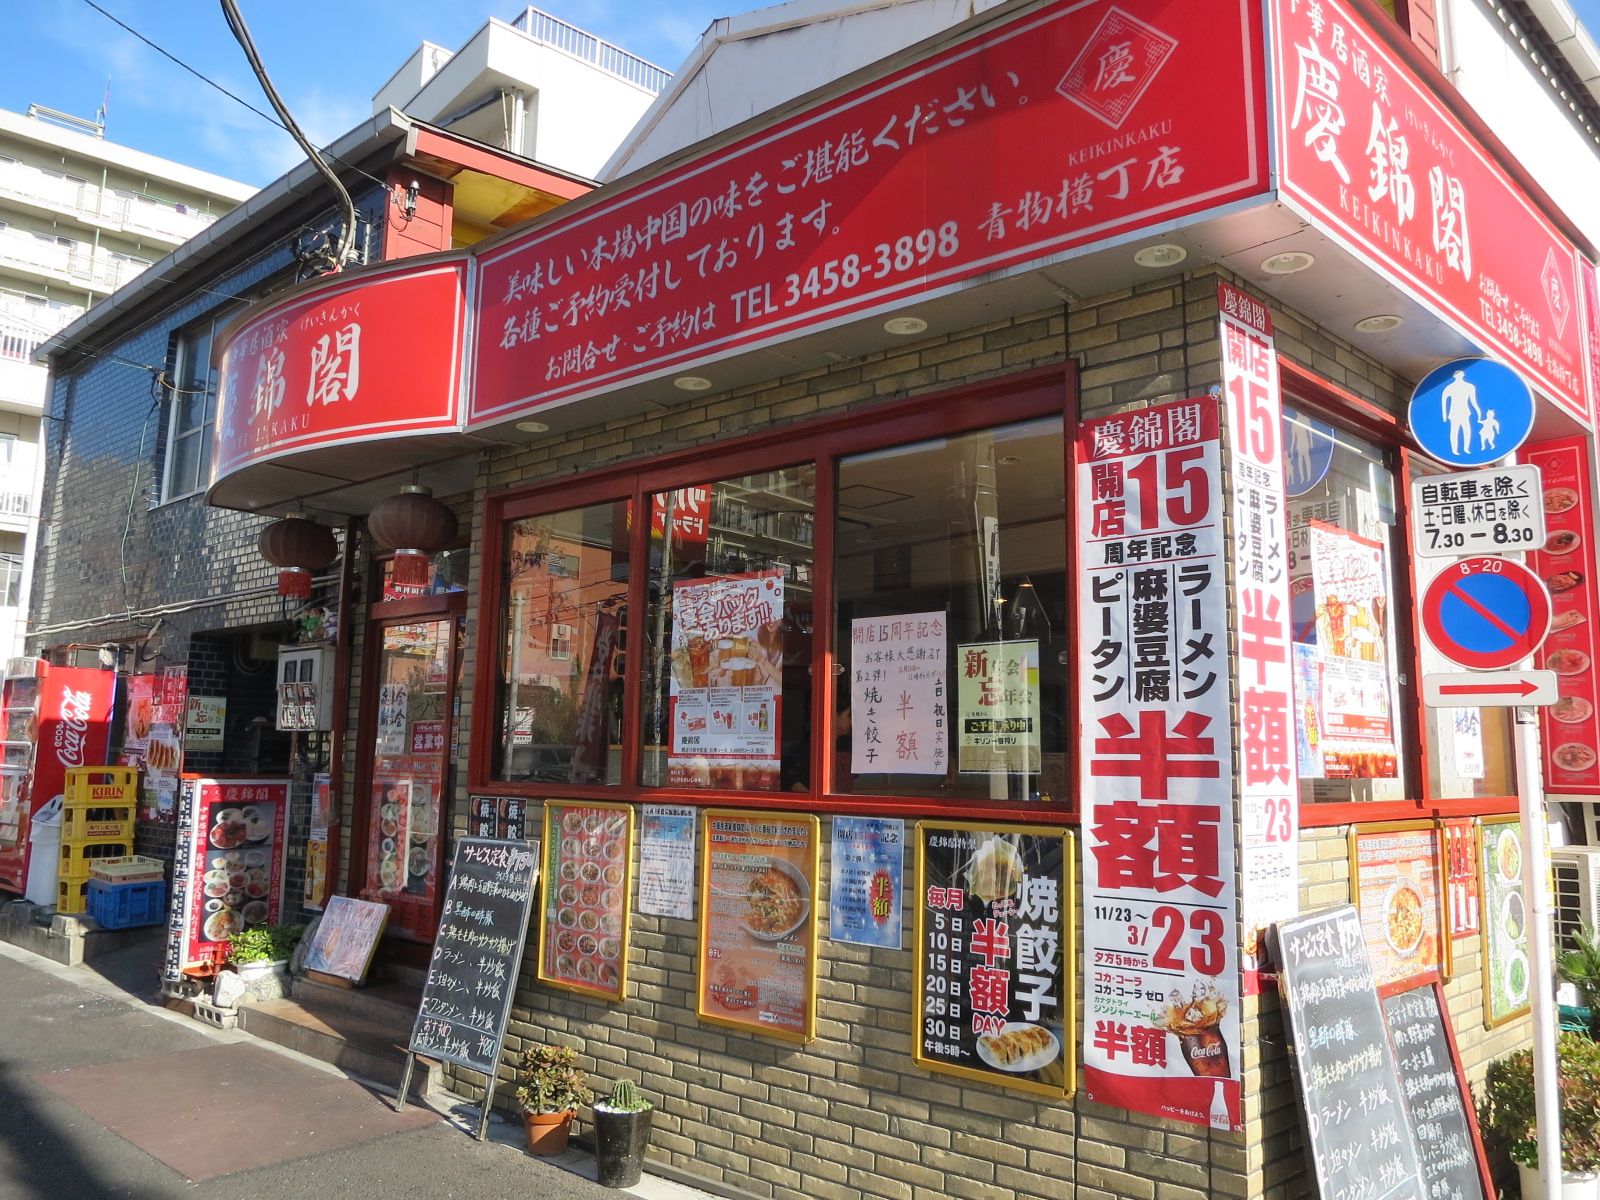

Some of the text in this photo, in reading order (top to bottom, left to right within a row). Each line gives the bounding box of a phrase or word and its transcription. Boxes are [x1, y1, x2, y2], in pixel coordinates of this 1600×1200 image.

[1094, 41, 1136, 92] 慶
[1067, 119, 1173, 167] KEIKINKAKU
[1291, 38, 1471, 282] 慶錦閣
[730, 283, 779, 324] TEL
[786, 221, 960, 307] 3458-3898
[977, 145, 1185, 242] 青物横丁店
[1339, 183, 1444, 286] KEIKINKAKU
[1224, 289, 1266, 333] 慶錦閣
[1226, 325, 1270, 380] 開店
[1091, 402, 1201, 457] 慶錦閣
[1228, 375, 1276, 465] 15
[1091, 446, 1211, 538] 開店 15
[1421, 475, 1529, 504] 自転車を除く
[1104, 532, 1198, 565] 周年記念
[1460, 559, 1503, 576] 8-20
[1090, 572, 1126, 703] ピータン
[1133, 567, 1170, 703] 麻婆豆腐
[1178, 564, 1217, 701] ラーメン
[1241, 588, 1293, 787] 半額
[56, 685, 92, 768] Coca-Cola
[414, 734, 444, 750] 営業中
[896, 689, 919, 761] 半額
[92, 787, 124, 797] KIRIN
[1090, 709, 1227, 899] 半額
[928, 886, 964, 911] 毎月
[968, 917, 1012, 1017] 半額
[1016, 873, 1059, 1022] 焼餃子
[1150, 905, 1227, 976] 23
[1093, 971, 1142, 986] コカ・コーラ
[1093, 983, 1165, 1003] コカ・コーラ ゼロ
[972, 1013, 1007, 1039] DAY
[1093, 1019, 1168, 1069] 半額
